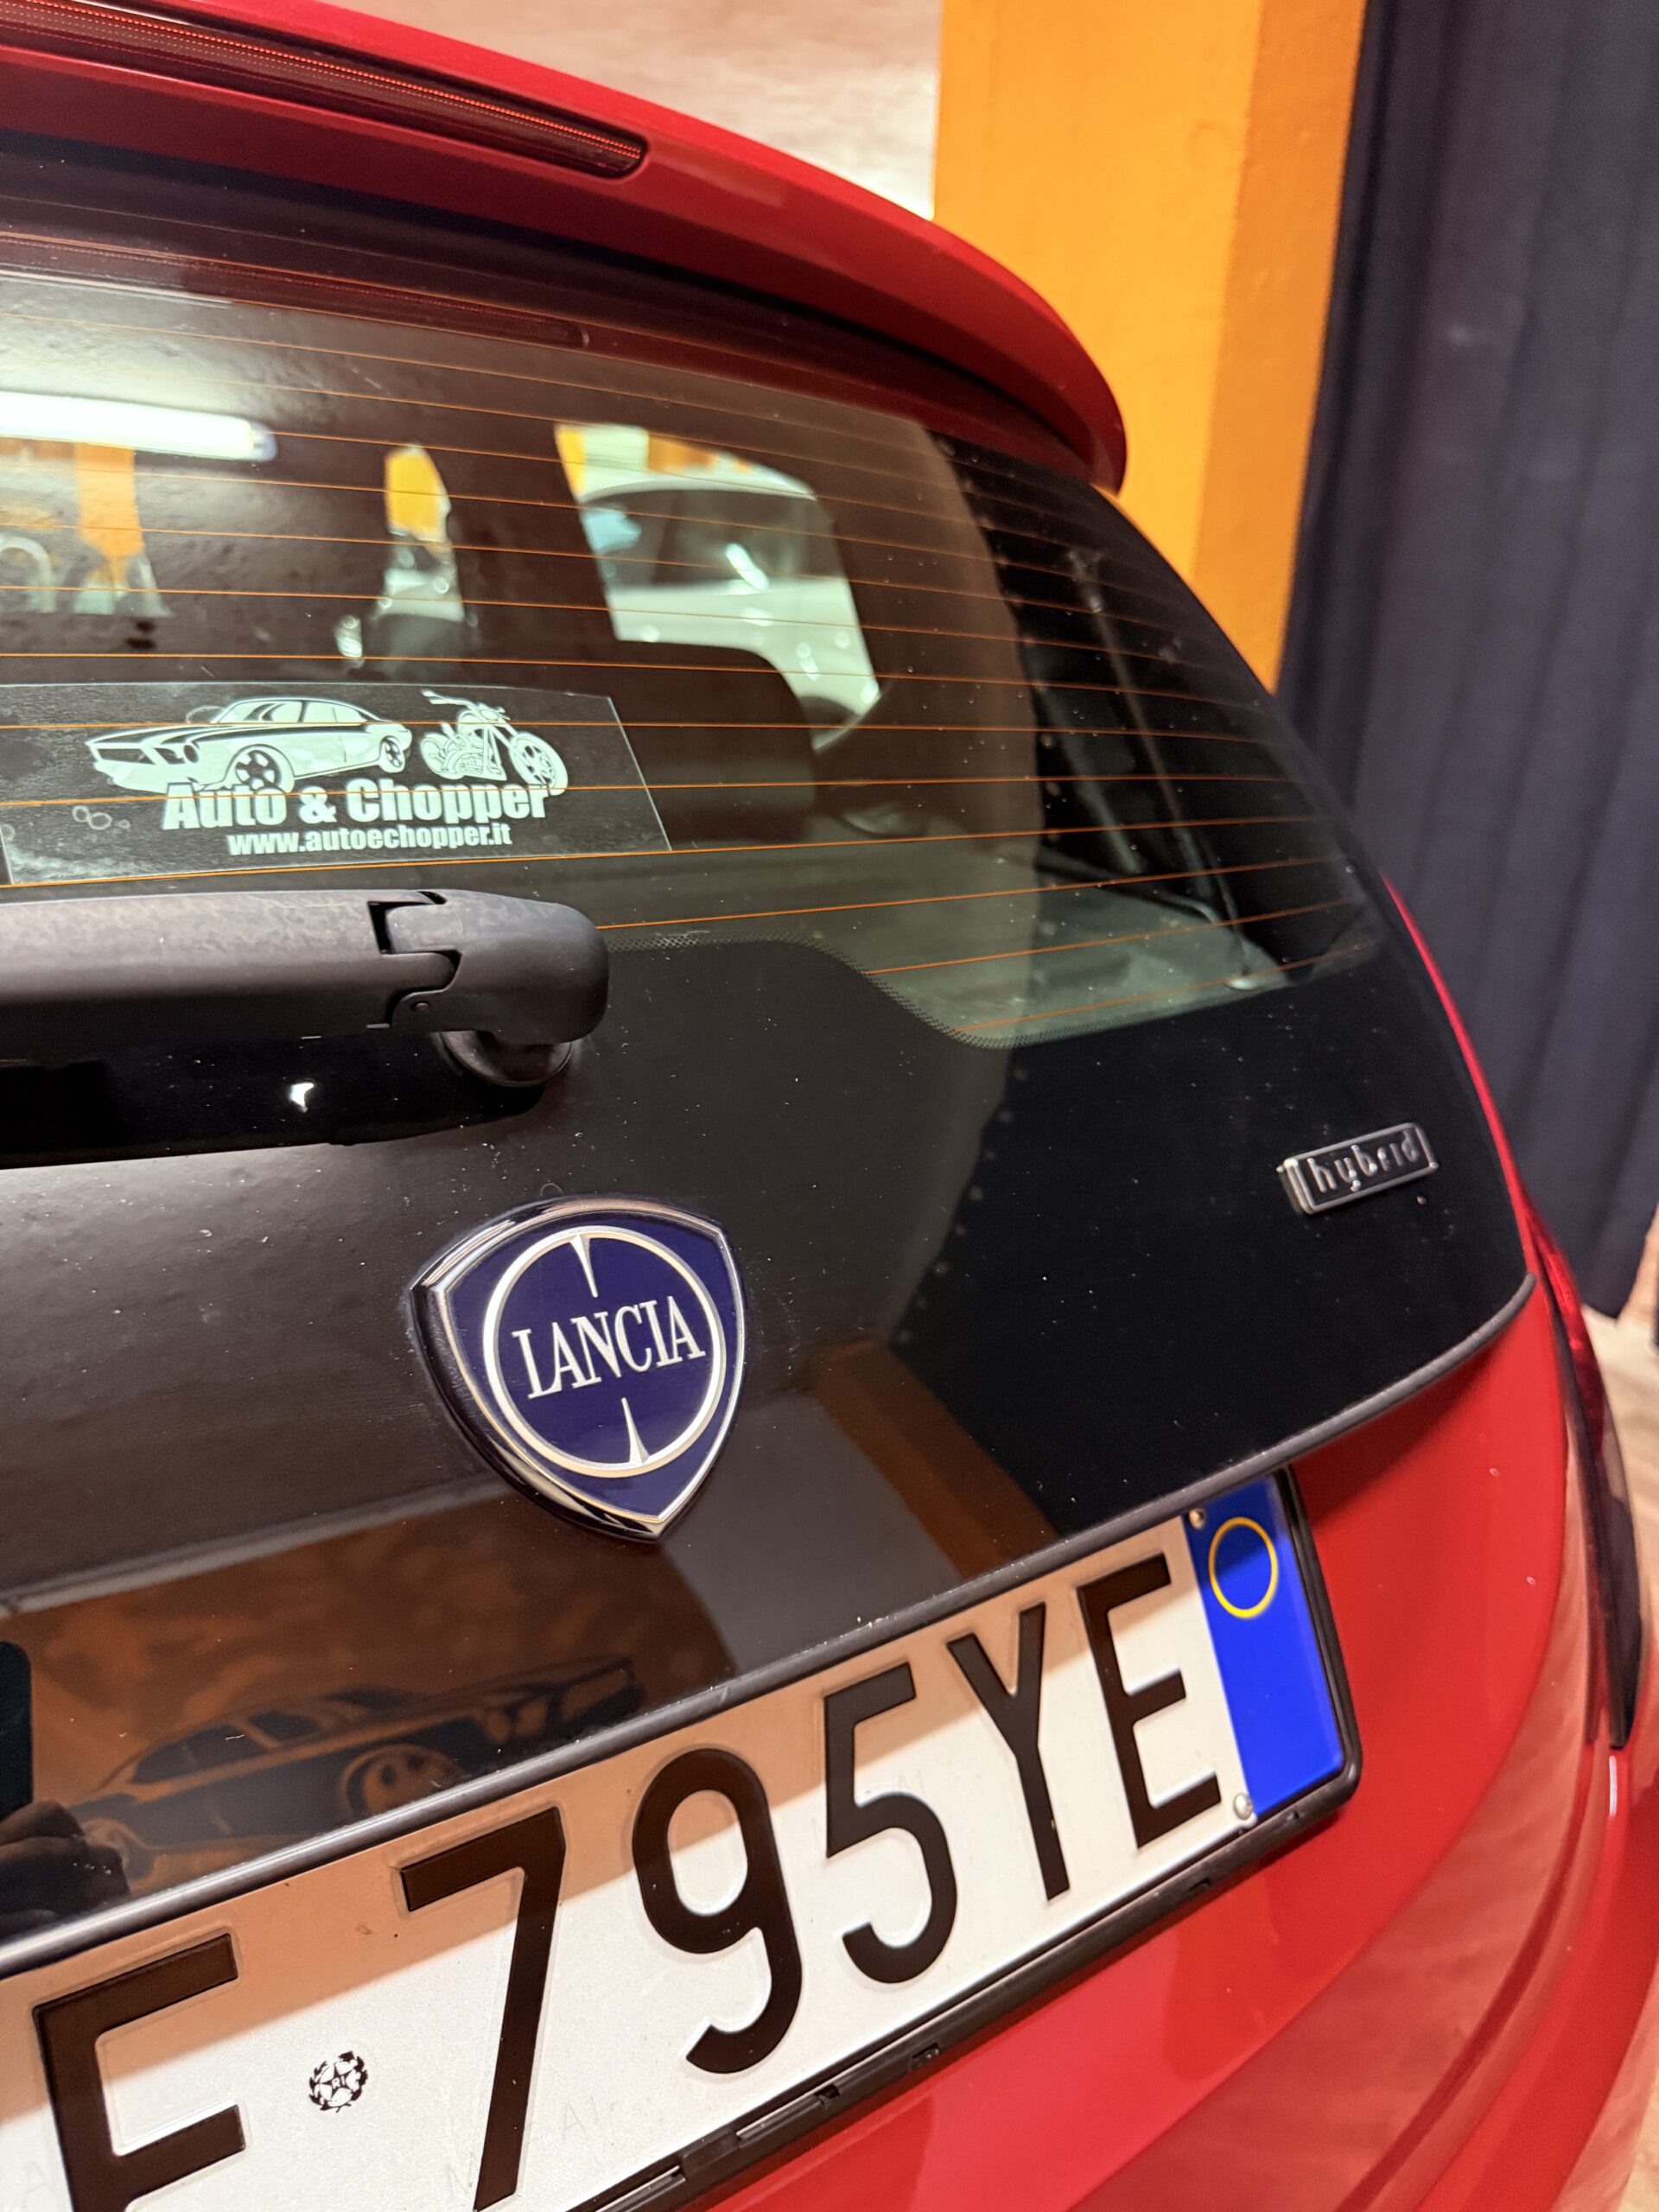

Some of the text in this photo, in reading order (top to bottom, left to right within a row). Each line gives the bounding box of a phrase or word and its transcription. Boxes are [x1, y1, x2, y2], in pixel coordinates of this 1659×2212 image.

[162, 778, 549, 830] Auto & Chopper
[226, 822, 513, 855] www.autoechopper.it
[1306, 1128, 1420, 1192] hybrid
[511, 1295, 706, 1400] LANCIA
[400, 1552, 1221, 2211] 795YE
